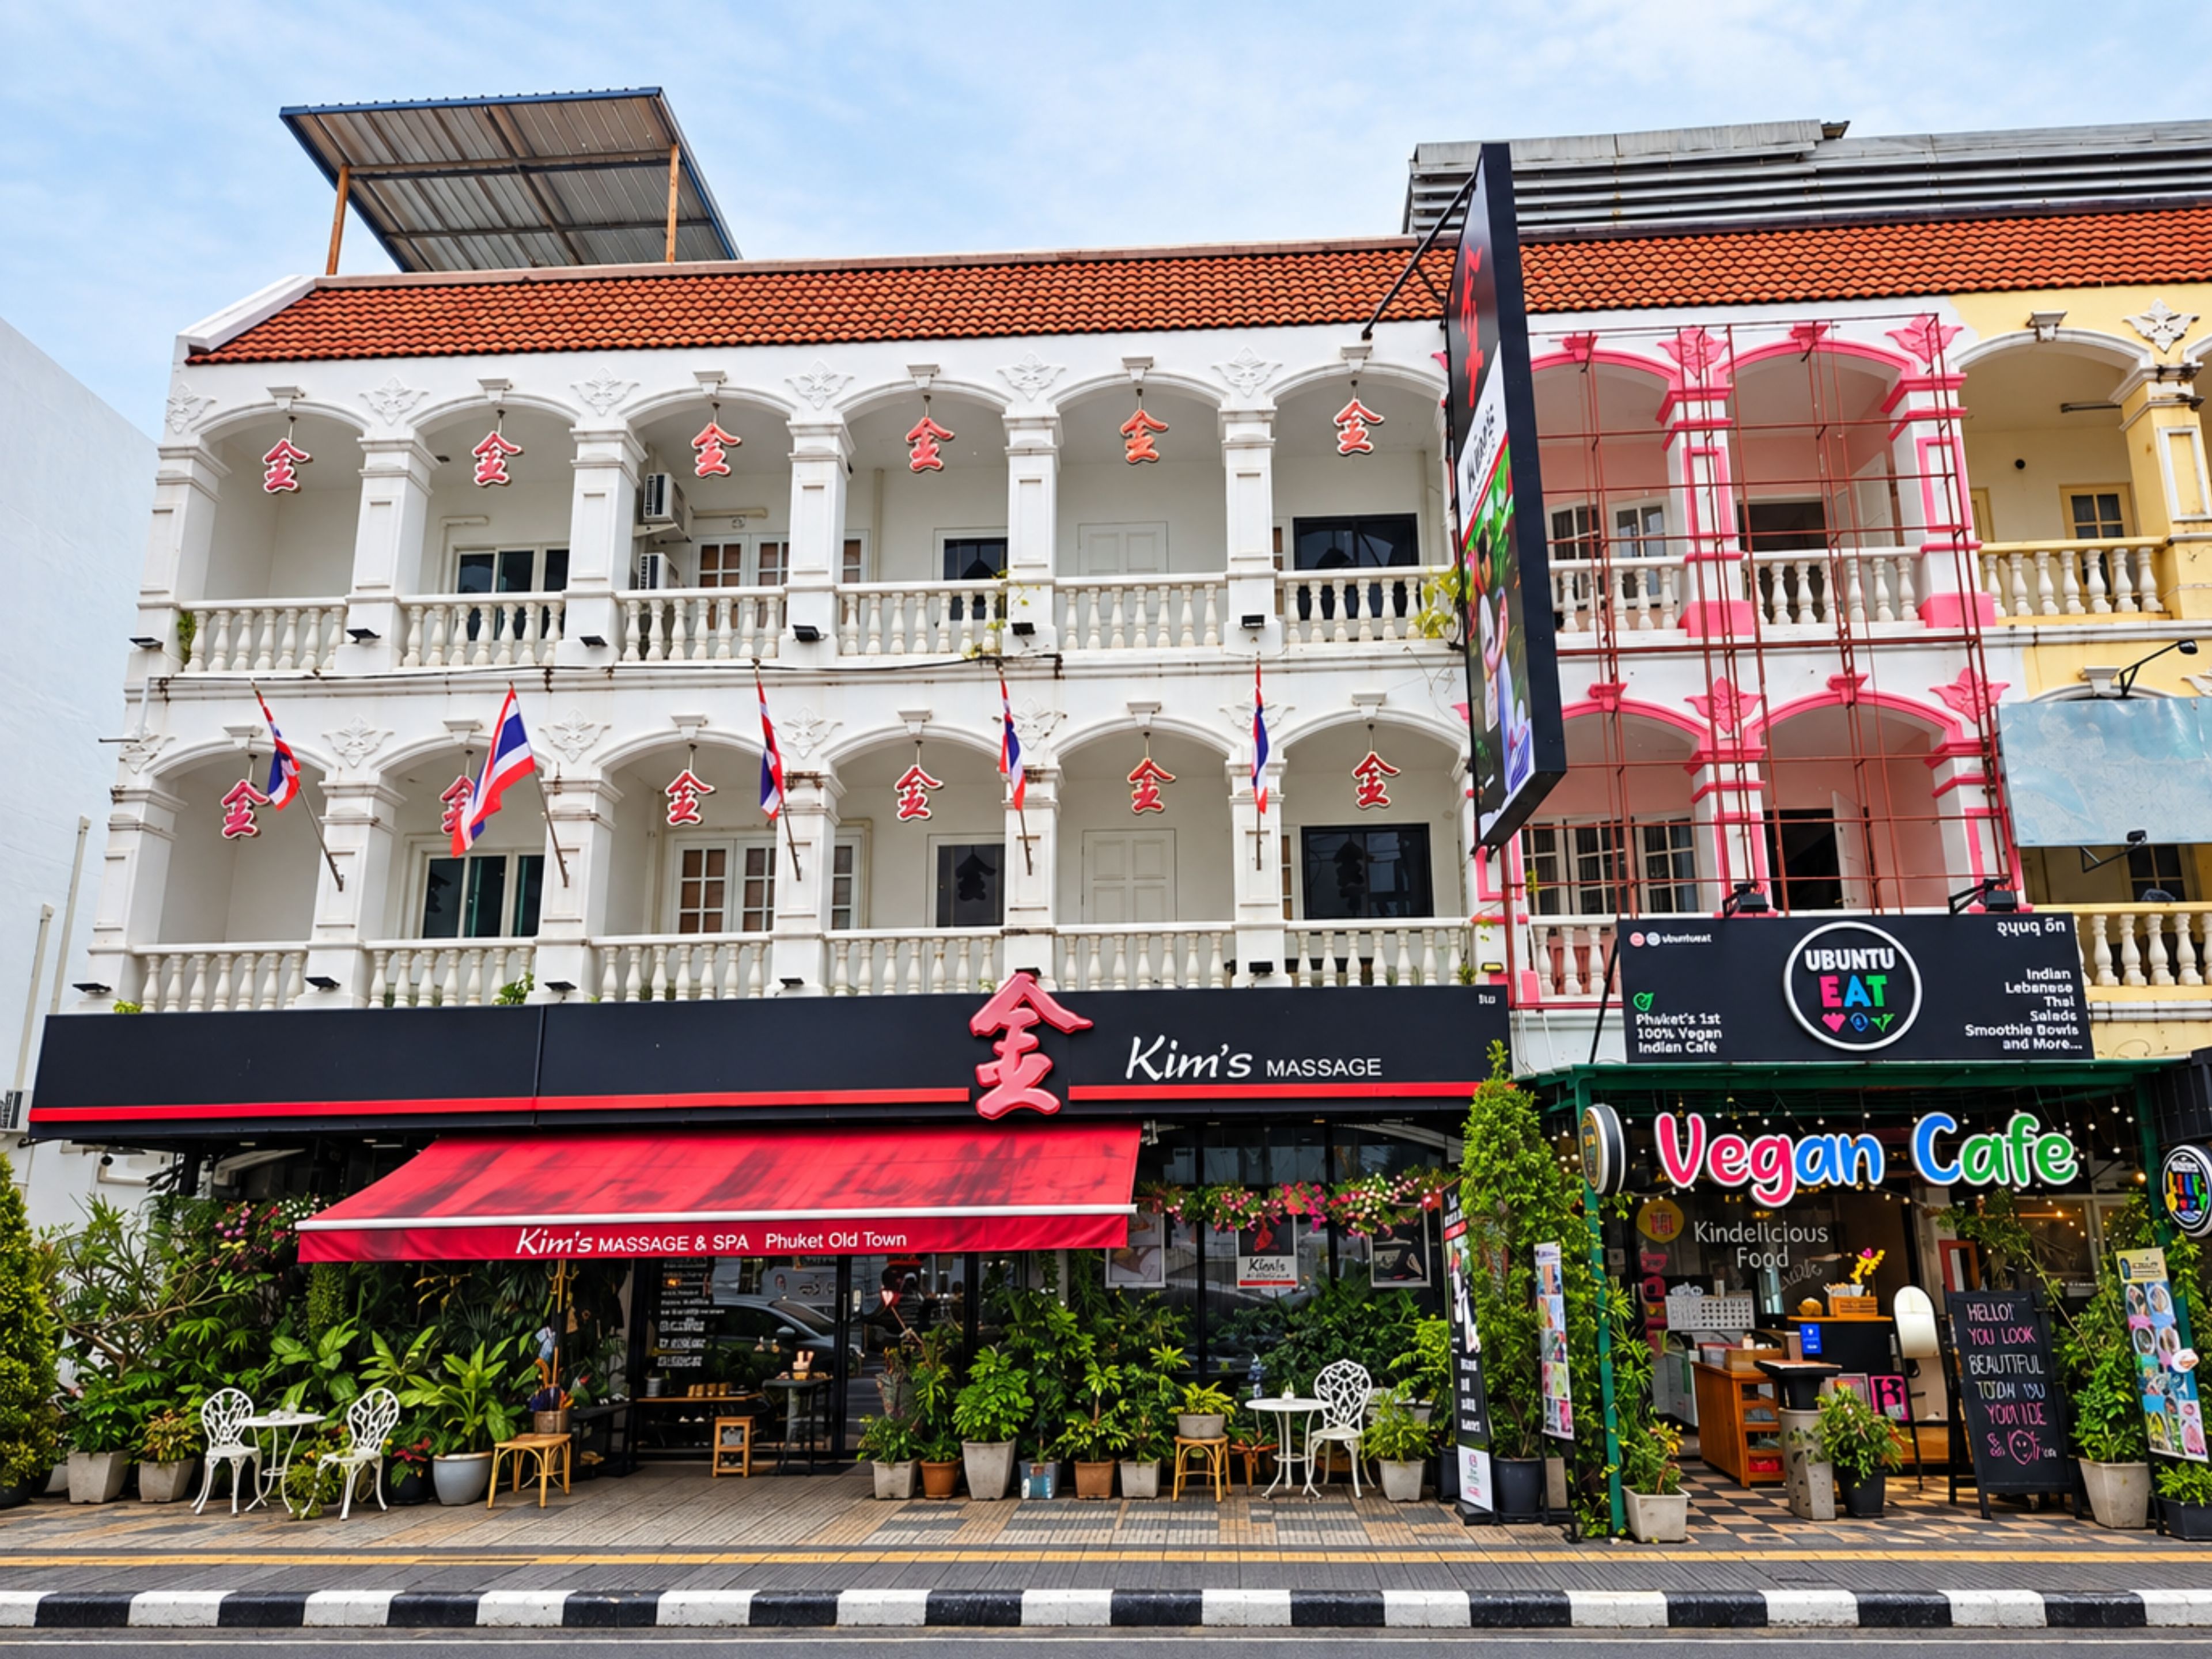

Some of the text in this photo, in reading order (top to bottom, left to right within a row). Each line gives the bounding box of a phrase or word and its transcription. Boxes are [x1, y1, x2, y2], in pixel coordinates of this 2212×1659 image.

[1804, 948, 1896, 972] UBUNTU
[2026, 967, 2072, 980] Indian
[1819, 975, 1887, 1008] EAT
[2043, 995, 2075, 1007] Thai
[1699, 1013, 1721, 1025] 1st
[1637, 1027, 1723, 1042] 100% Vegan
[1965, 1024, 2033, 1036] Smoothie
[1638, 1041, 1683, 1054] Indian
[2002, 1037, 2029, 1050] and
[1126, 1035, 1382, 1081] Kim's MASSAGE
[1656, 1111, 2078, 1207] Vegan Cafe
[1694, 1221, 1829, 1243] Kindelicious
[516, 1228, 907, 1256] Kim's MASSAGE & SPA Phuket Old Town
[1736, 1247, 1789, 1268] Food
[1968, 1327, 2037, 1346] YOU LOOK
